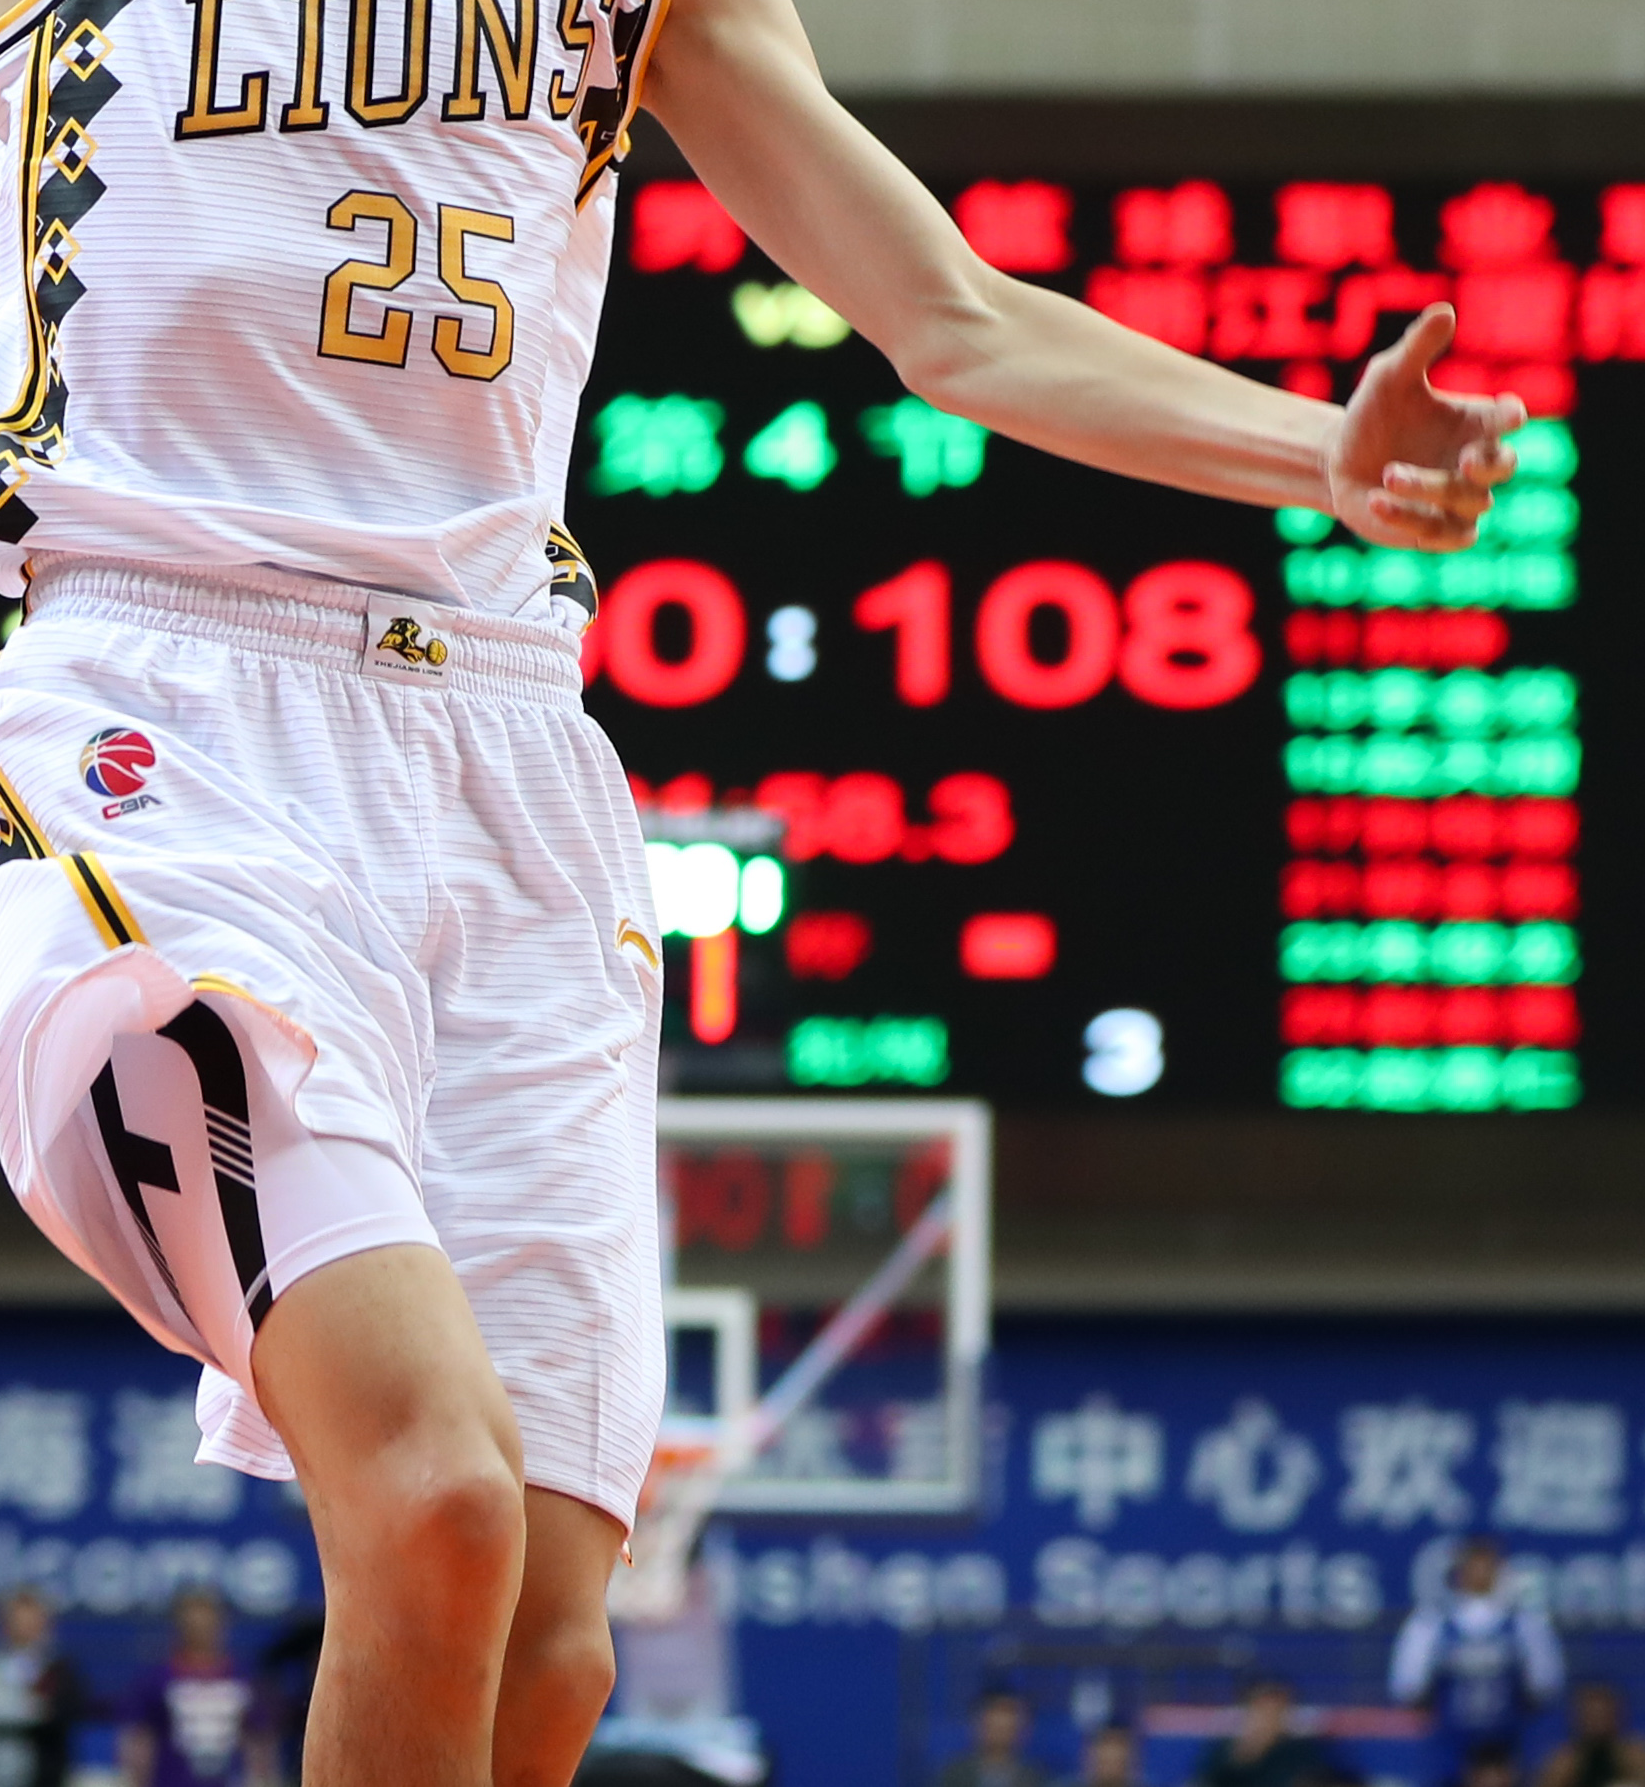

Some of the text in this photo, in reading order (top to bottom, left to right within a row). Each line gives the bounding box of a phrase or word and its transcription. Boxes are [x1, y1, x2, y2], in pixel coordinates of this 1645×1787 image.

[317, 189, 514, 383] 25
[578, 558, 748, 709] 0
[854, 558, 1264, 711] 108
[102, 794, 163, 820] CBA
[1034, 1535, 1380, 1629] Sports
